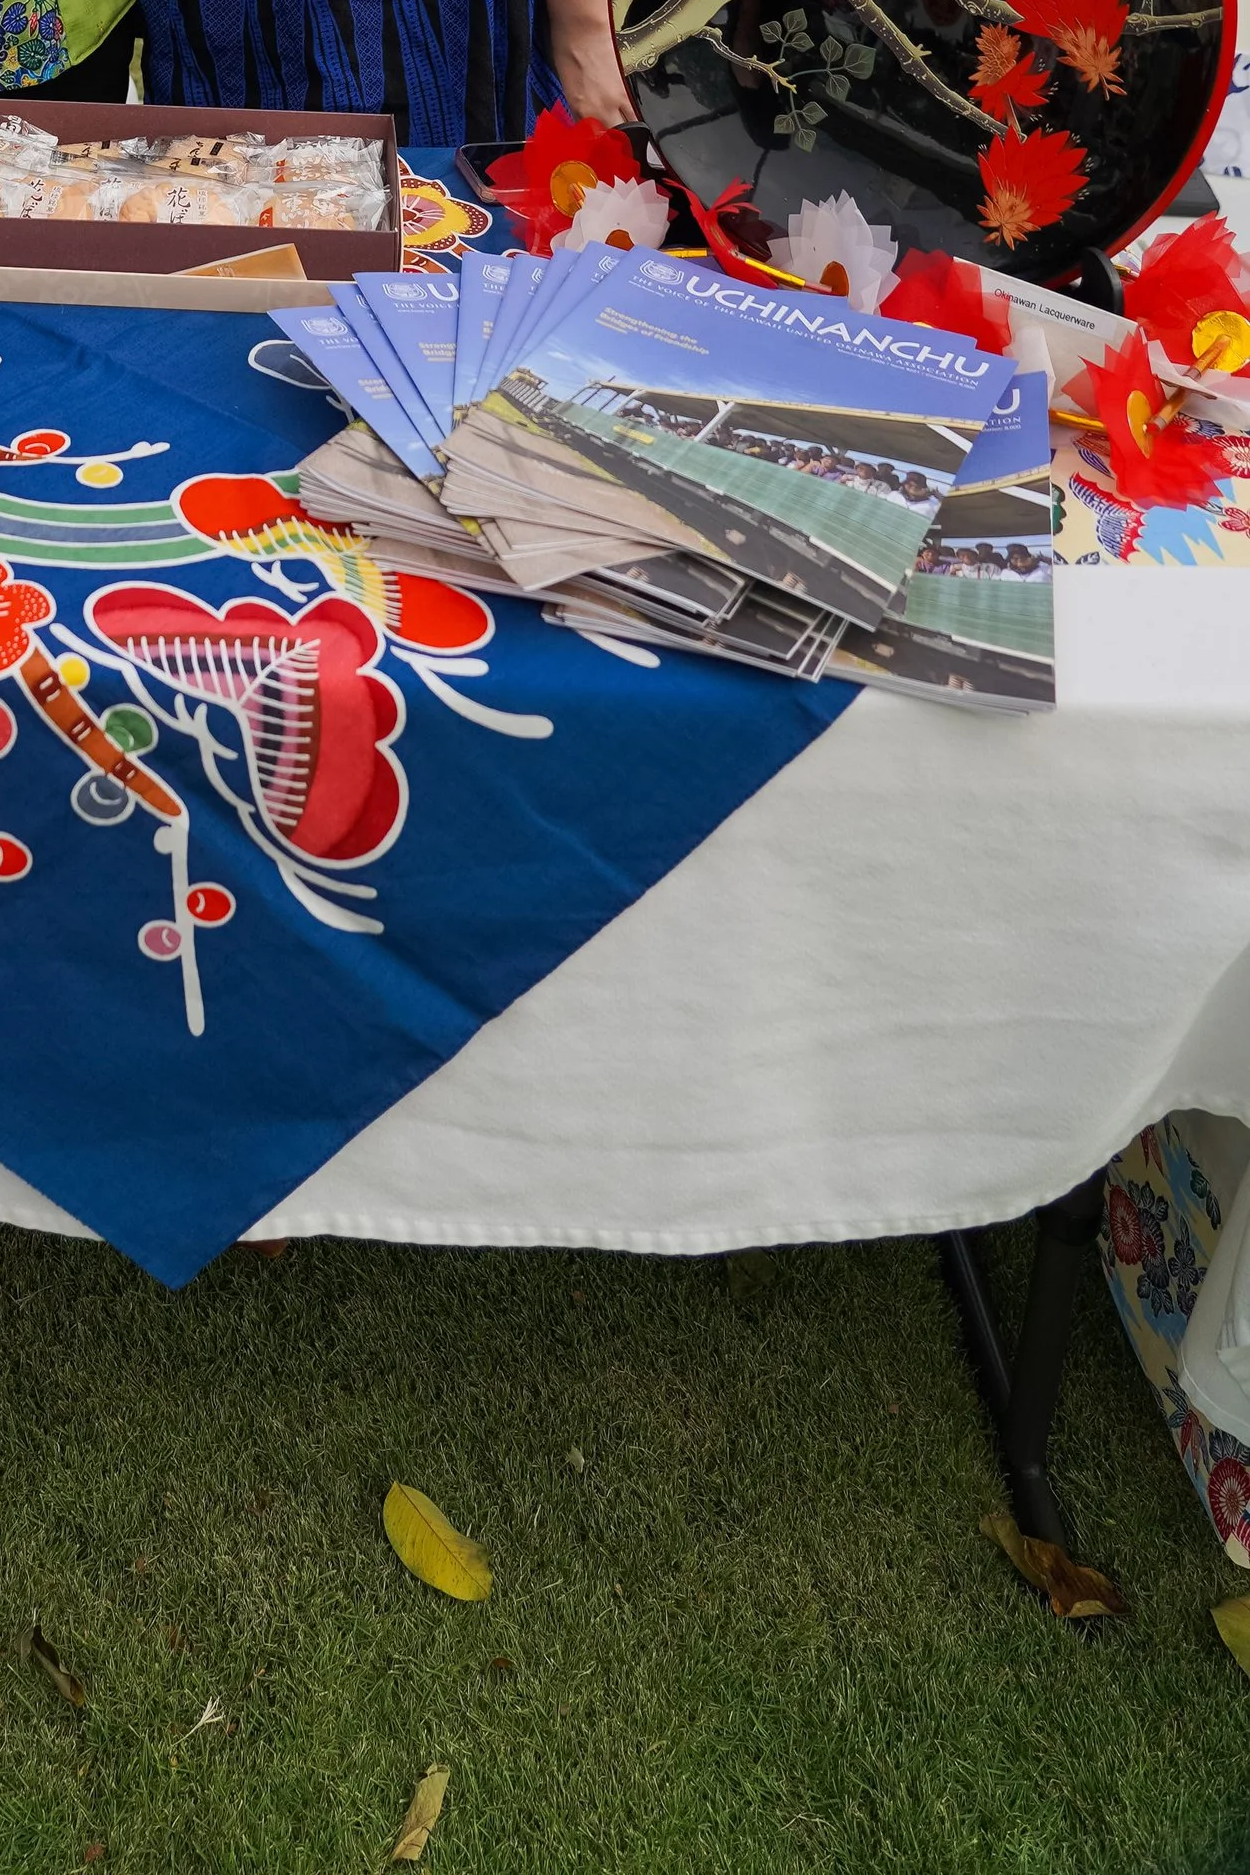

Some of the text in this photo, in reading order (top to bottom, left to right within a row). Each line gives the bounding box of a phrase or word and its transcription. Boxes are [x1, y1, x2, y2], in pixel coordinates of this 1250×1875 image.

[657, 284, 691, 301] VOICE
[694, 298, 710, 307] OF
[739, 312, 782, 331] HAWAII
[785, 327, 833, 345] UNITED
[835, 341, 892, 362] OKINAWA
[896, 358, 980, 387] ASSOCIATION
[685, 275, 990, 378] UCHINANCHU
[994, 288, 1096, 330] Okinawan Lacquerware
